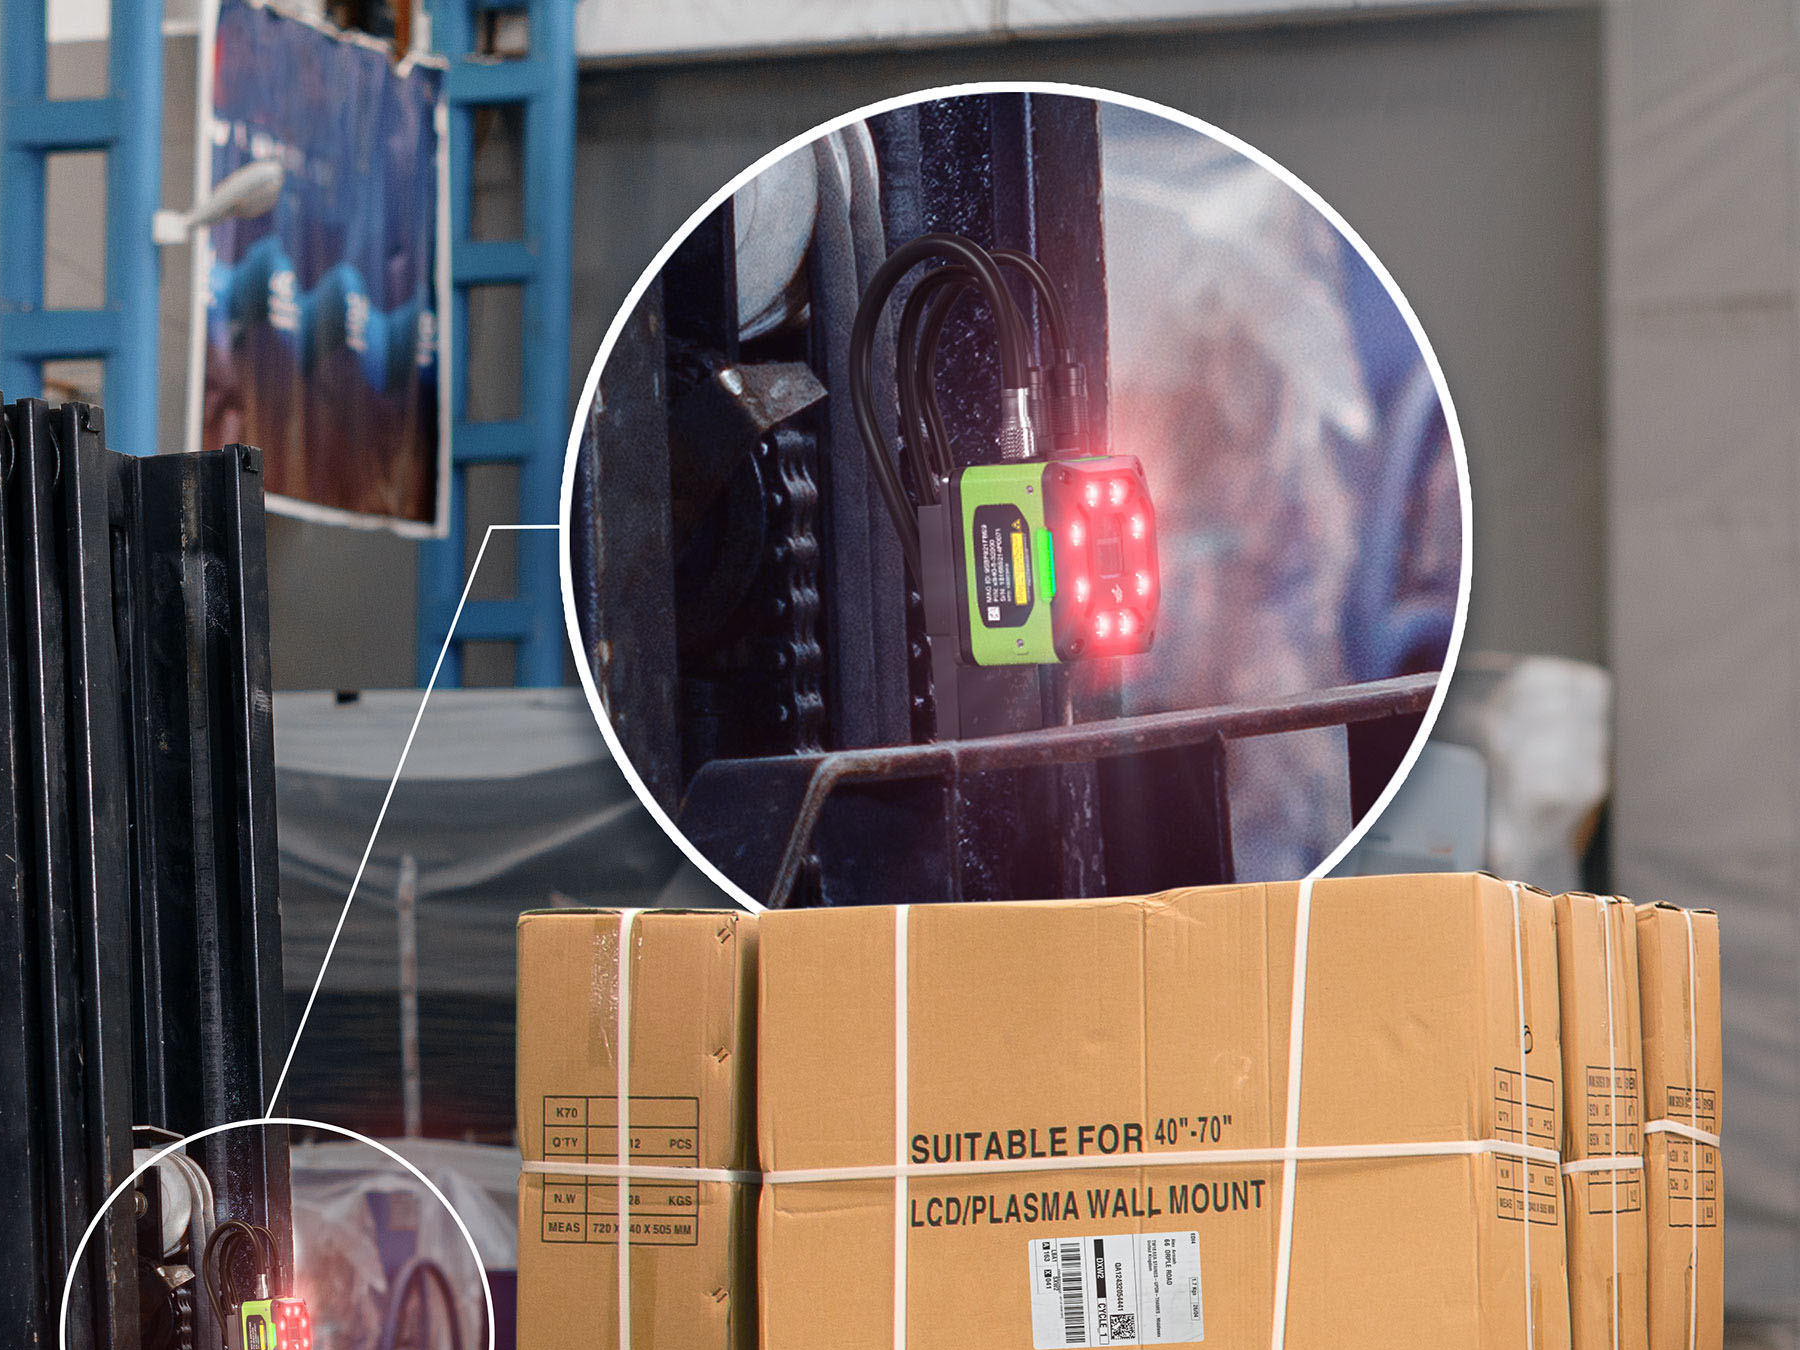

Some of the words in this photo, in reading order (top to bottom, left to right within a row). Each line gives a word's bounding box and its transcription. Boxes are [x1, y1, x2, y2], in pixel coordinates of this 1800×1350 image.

[556, 1108, 578, 1118] K70
[669, 1139, 692, 1149] PCS
[911, 1126, 1068, 1164] SUITABLE
[1078, 1123, 1143, 1155] FOR
[1154, 1114, 1232, 1145] 40"-70"
[668, 1196, 692, 1206] KGS
[911, 1191, 1079, 1227] LCD/PLASMA
[1087, 1186, 1161, 1218] WALL
[1169, 1180, 1265, 1214] MOUNT
[548, 1223, 580, 1232] MEAS
[593, 1224, 611, 1233] 720
[644, 1225, 650, 1234] X
[653, 1225, 671, 1234] 505
[674, 1225, 691, 1234] MM
[1096, 1258, 1104, 1279] DXW2
